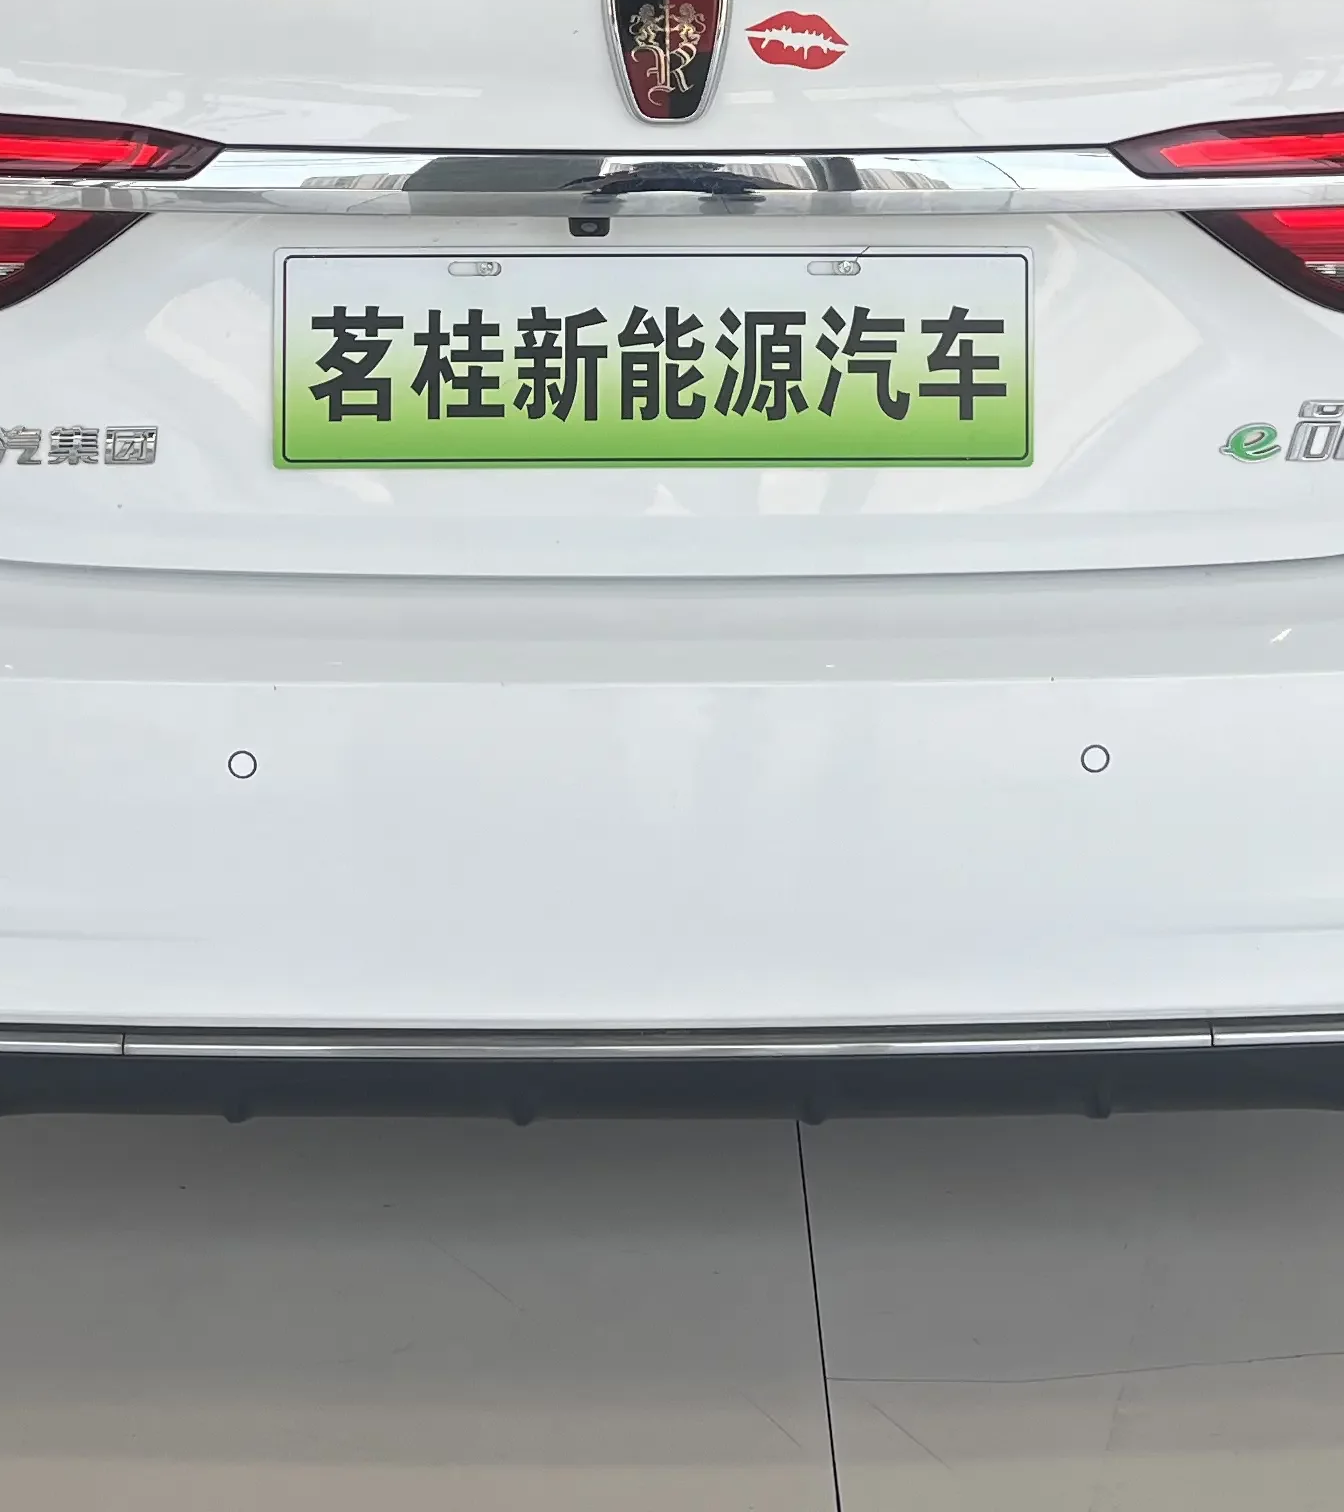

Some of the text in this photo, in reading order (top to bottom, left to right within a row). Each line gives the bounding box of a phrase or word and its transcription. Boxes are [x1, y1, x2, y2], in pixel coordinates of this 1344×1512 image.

[309, 305, 1008, 423] 茗桂新能源汽车
